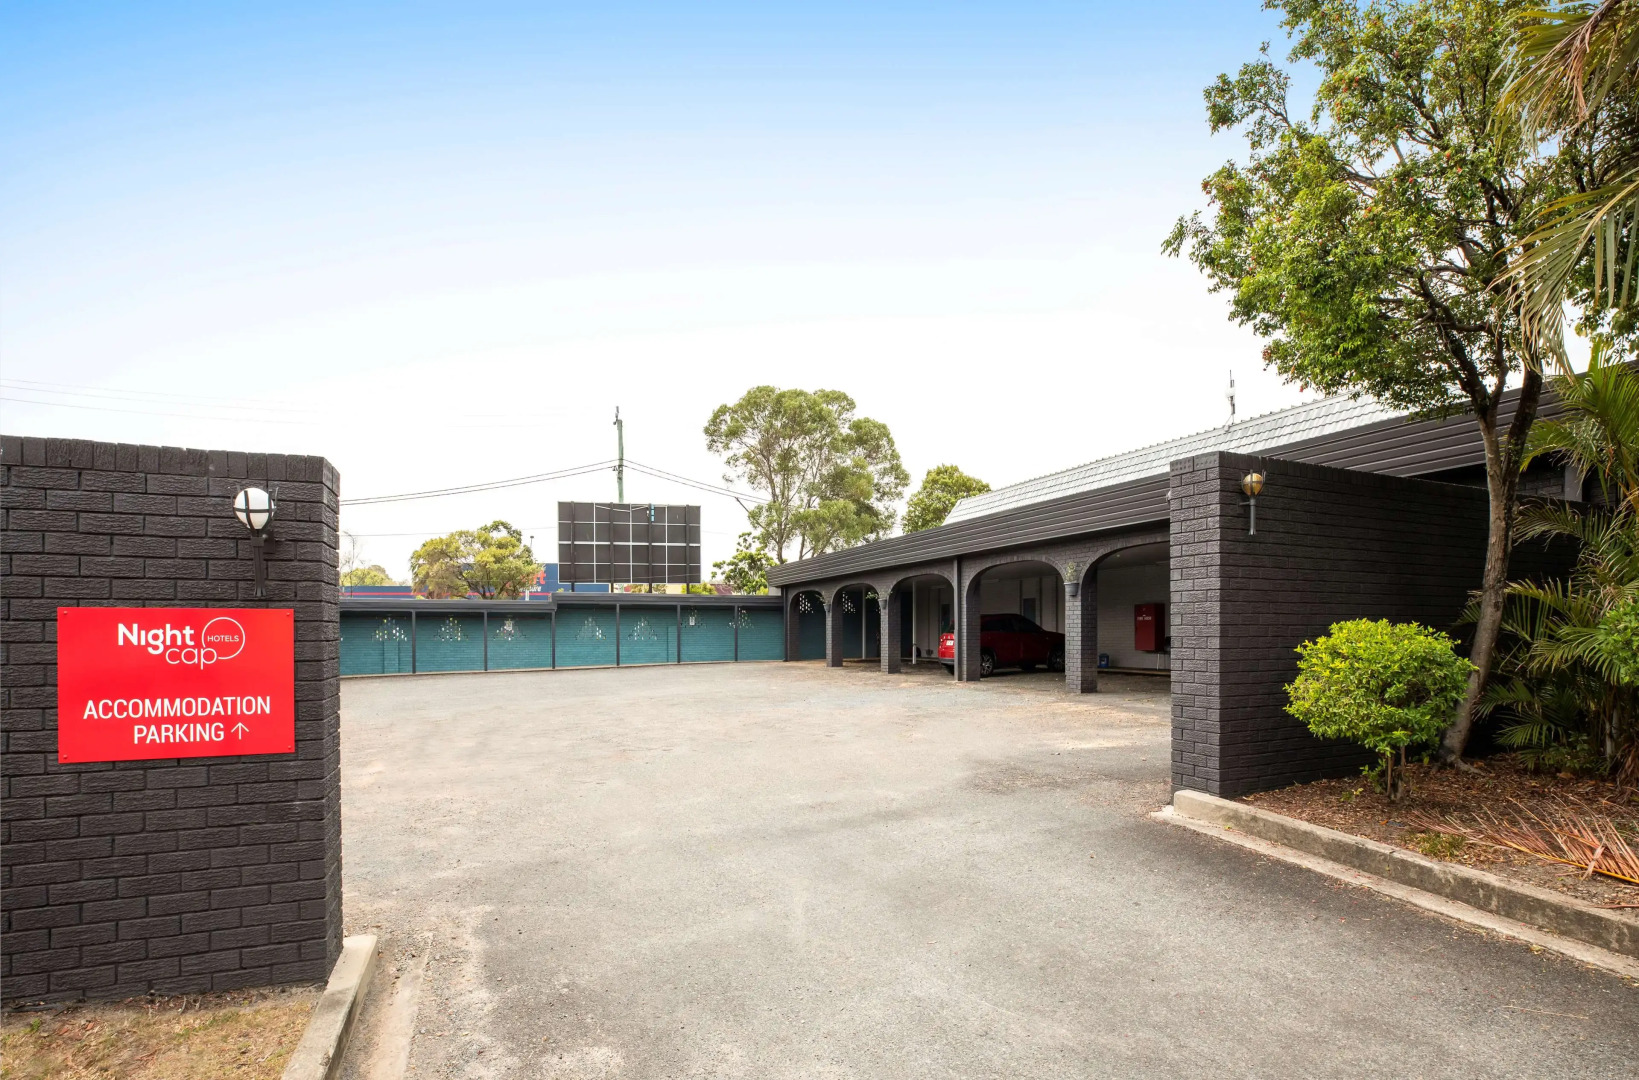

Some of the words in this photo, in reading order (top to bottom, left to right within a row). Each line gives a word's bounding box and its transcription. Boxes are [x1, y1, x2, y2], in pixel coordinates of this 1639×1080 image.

[117, 623, 194, 655] Night
[207, 634, 240, 643] HOTELS
[165, 647, 218, 670] cap
[83, 696, 271, 720] ACCOMMODATION
[133, 723, 225, 744] PARKING
